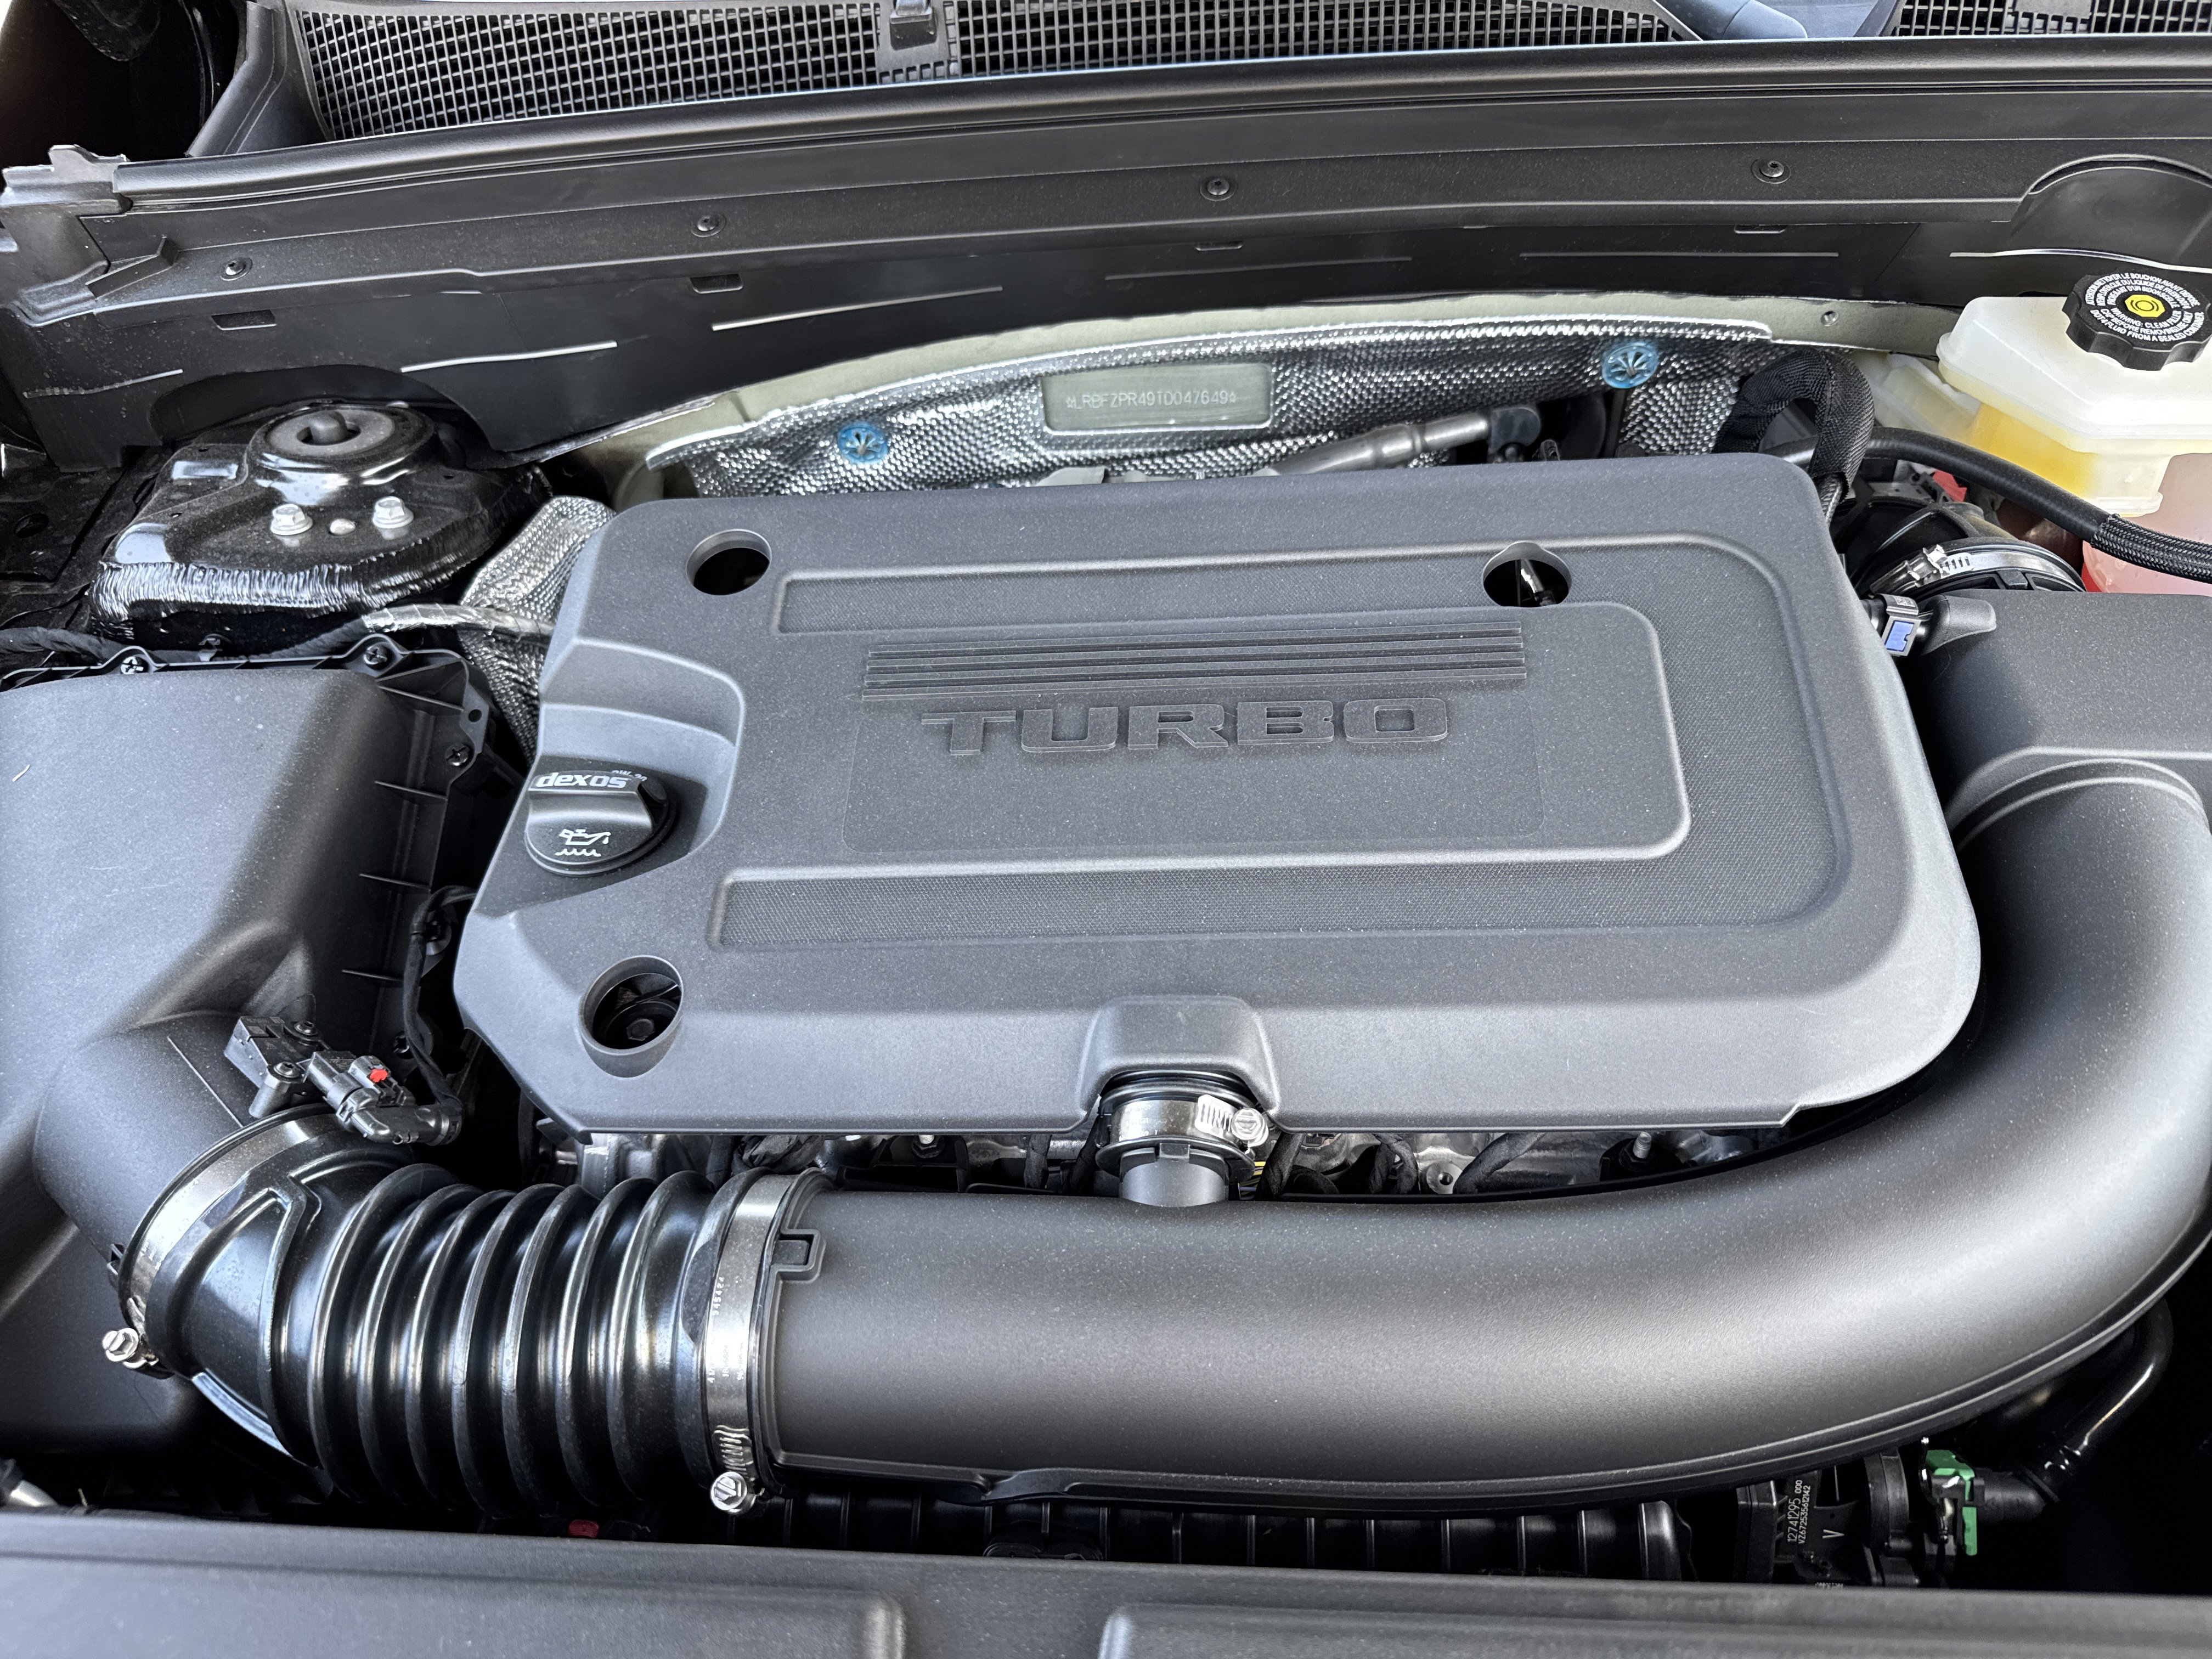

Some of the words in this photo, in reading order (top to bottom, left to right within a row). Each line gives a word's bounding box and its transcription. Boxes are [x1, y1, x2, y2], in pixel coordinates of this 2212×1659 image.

[2130, 273, 2163, 284] BOUCHON
[2160, 279, 2184, 292] AVANT
[2100, 308, 2115, 319] CAP
[2111, 316, 2140, 333] BEFORE
[2110, 307, 2144, 329] WARNING:
[2144, 320, 2172, 329] CLEAN
[2104, 320, 2127, 334] FLUID
[2126, 330, 2151, 341] FROM
[2157, 332, 2187, 342] SEALED
[921, 697, 1448, 756] TURBO
[536, 772, 630, 788] dexos
[1787, 1498, 1801, 1543] 12741295
[1795, 1480, 1803, 1494] 000
